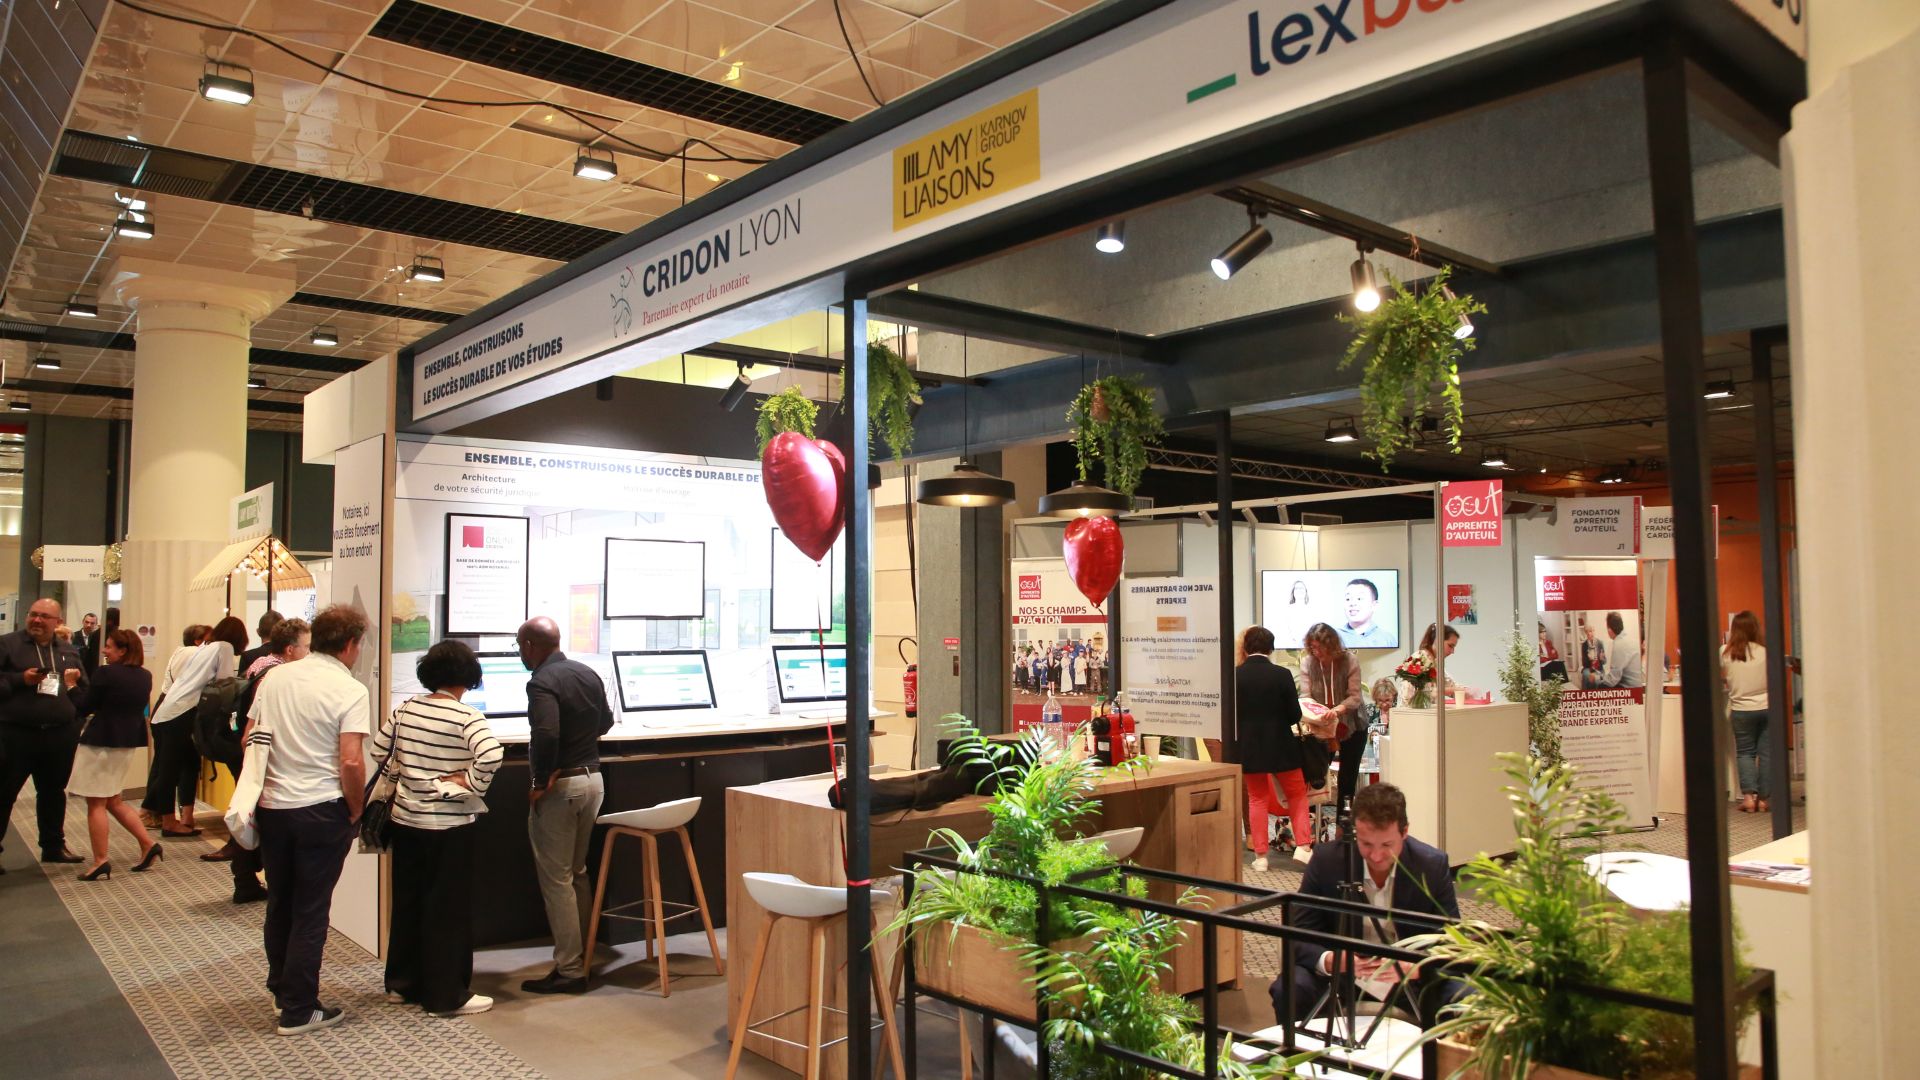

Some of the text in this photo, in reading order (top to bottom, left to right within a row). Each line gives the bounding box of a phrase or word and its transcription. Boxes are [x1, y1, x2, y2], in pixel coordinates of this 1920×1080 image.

[980, 105, 1028, 138] KARNOV
[980, 126, 1021, 154] GROUP
[903, 157, 995, 219] LIAISONS
[642, 198, 801, 298] CRIDON LYON
[642, 273, 751, 327] Partenaire expert du notaire
[424, 322, 524, 380] ENSEMBLE, CONSTRUISONS
[423, 337, 563, 406] LE SUCCÈS DURABLE DE VOS ÉTUDES
[464, 452, 760, 483] ENSEMBLE, CONSTRUISONS LE SUCCÈS DURABLE DE
[461, 473, 516, 484] Architecture
[434, 483, 445, 491] de
[447, 484, 469, 493] votre
[470, 485, 503, 495] sécurité
[343, 504, 363, 520] Notaires,
[1571, 509, 1621, 517] FONDATION
[1446, 520, 1497, 531] APPRENTIS
[1573, 516, 1618, 525] APPRENTIS
[1575, 525, 1617, 533] D'AUTEUIL
[1446, 531, 1498, 541] D'AUTEUIL
[1019, 606, 1087, 615] NOS 5 CHAMPS
[1019, 616, 1062, 625] D'ACTION
[1577, 690, 1588, 699] LA
[1588, 689, 1631, 699] FONDATION
[1600, 707, 1623, 716] D'UNE
[1590, 716, 1629, 725] EXPERTISE
